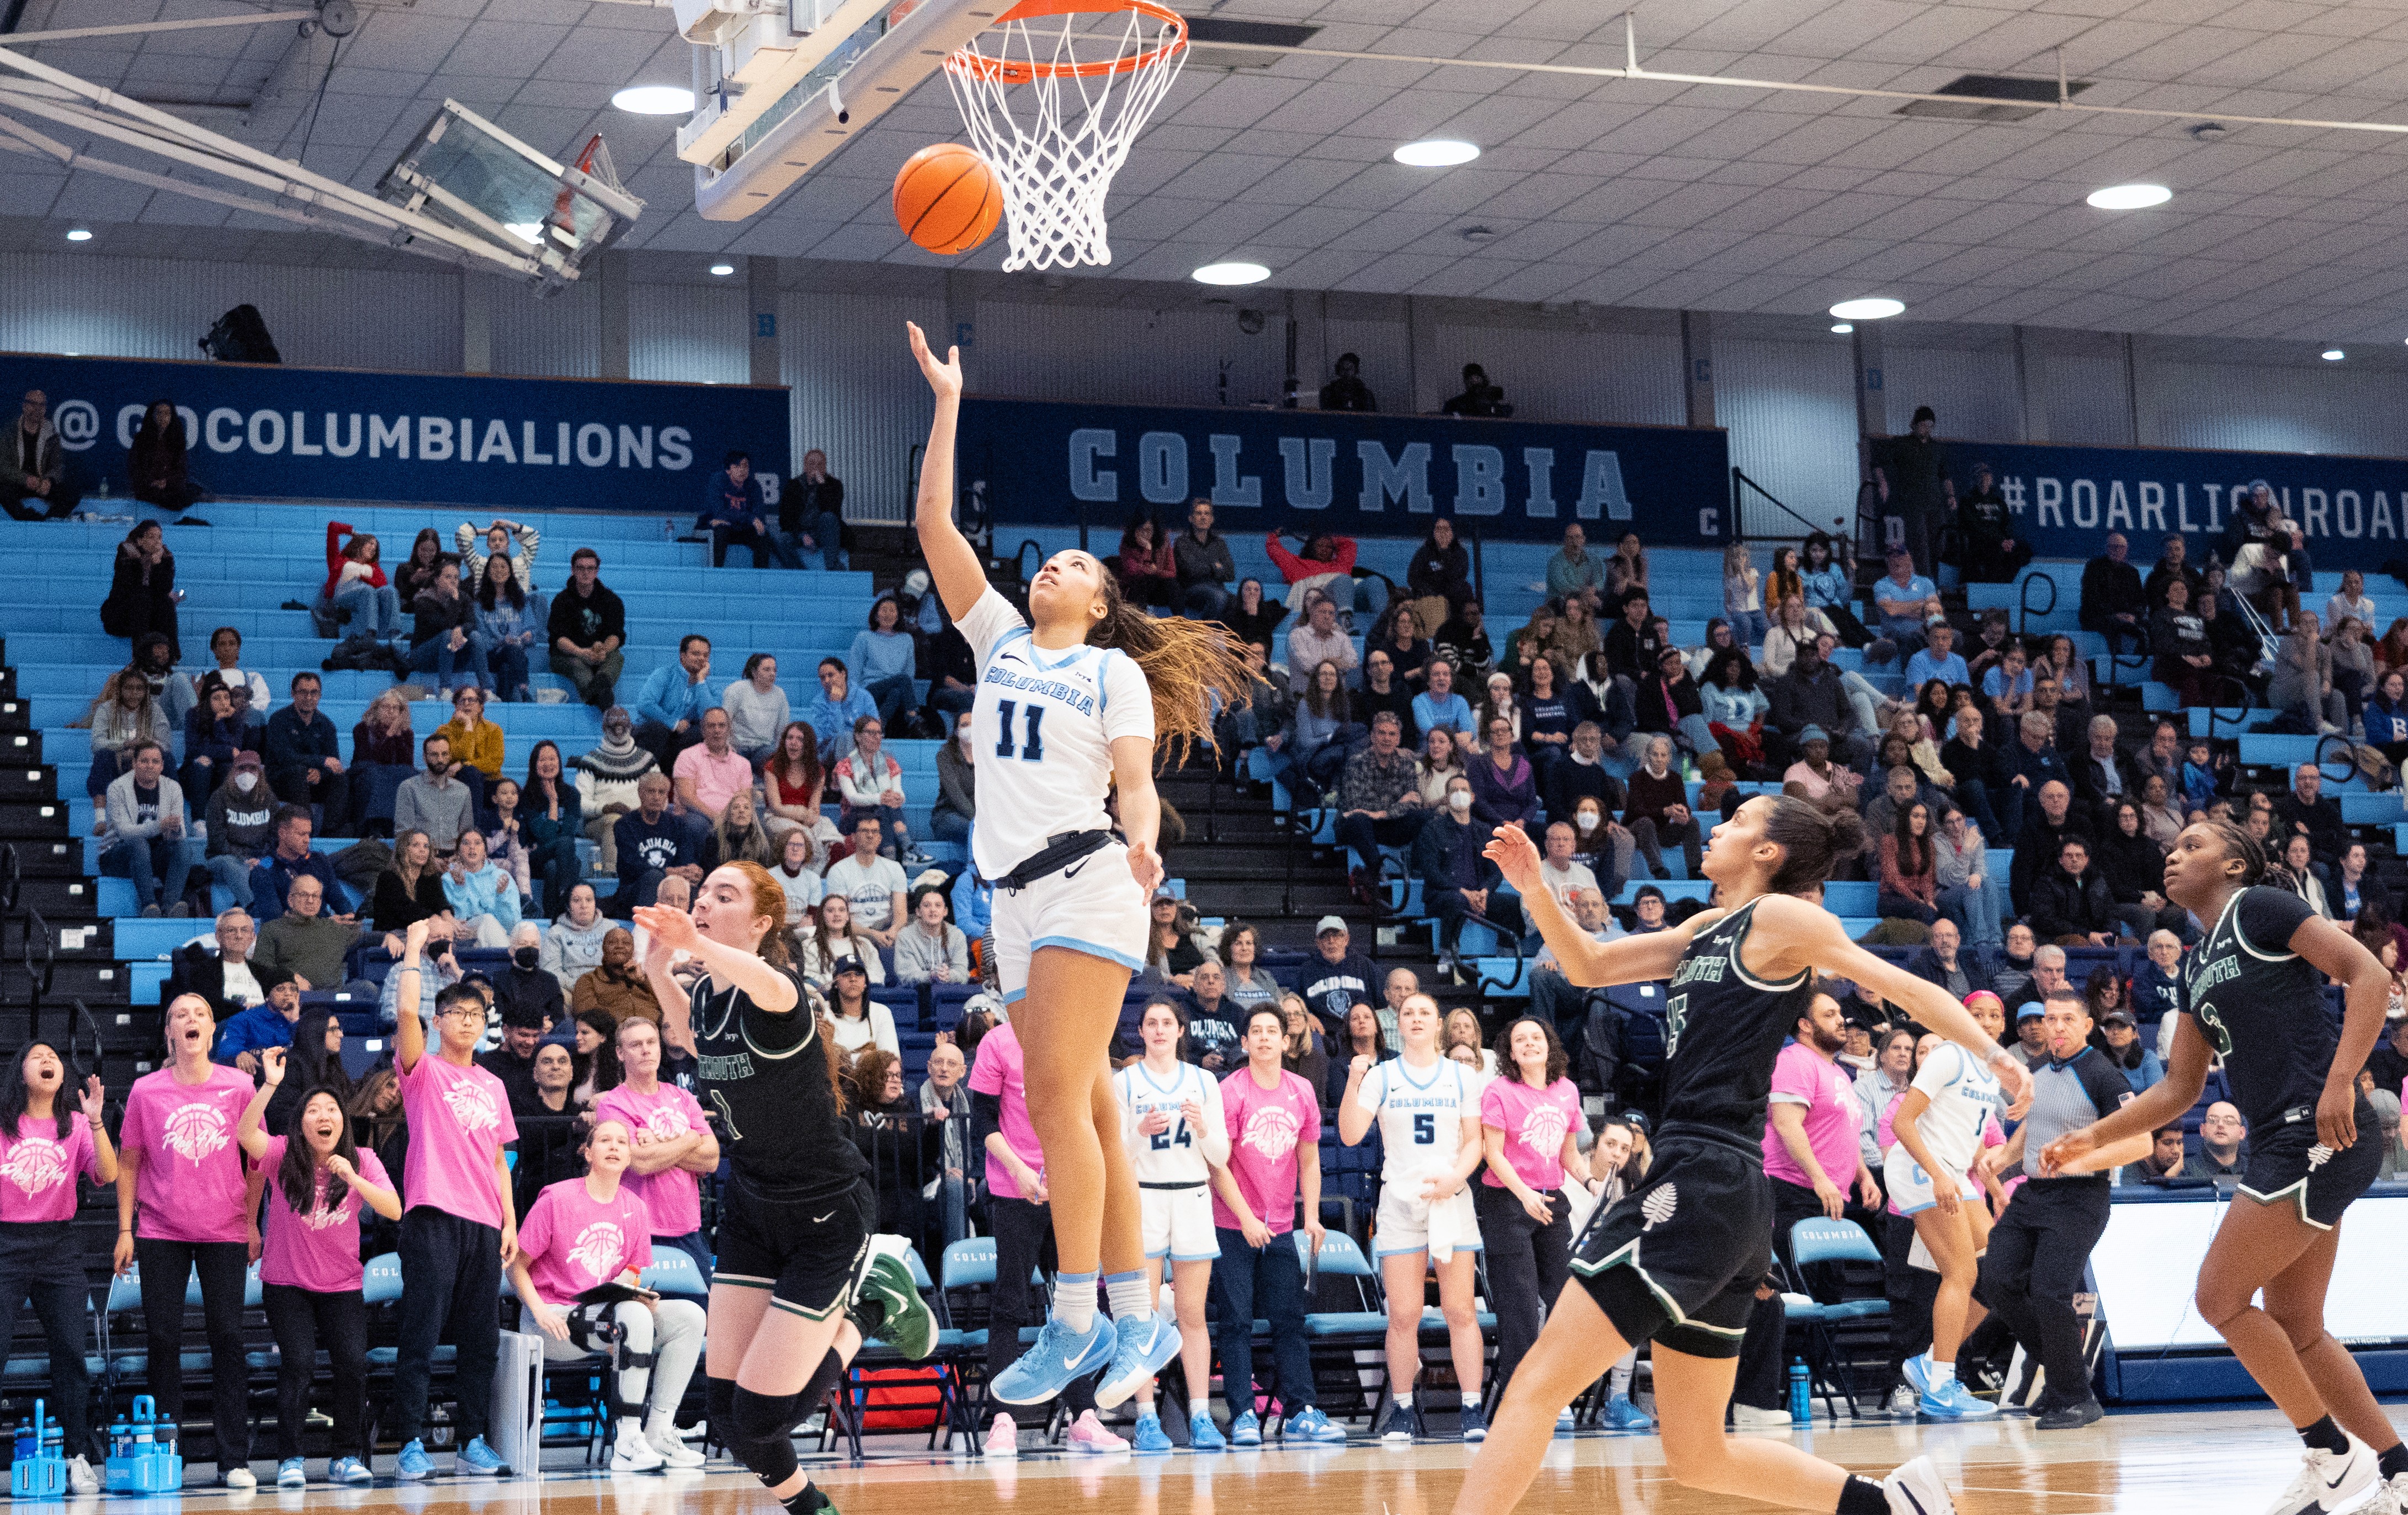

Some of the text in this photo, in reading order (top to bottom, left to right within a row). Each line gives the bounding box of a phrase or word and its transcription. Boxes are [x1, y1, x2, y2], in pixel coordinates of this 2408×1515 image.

[754, 473, 780, 504] B
[1069, 428, 1632, 521] COLUMBIA
[1699, 507, 1719, 535] C
[985, 666, 1094, 716] COLUMBIA
[996, 698, 1045, 763] 11
[2201, 1002, 2232, 1057] 3
[710, 1089, 743, 1140] 1
[1389, 1097, 1457, 1109] COLUMBIA
[1151, 1116, 1192, 1150] 24
[1413, 1114, 1435, 1145] 5
[1976, 1107, 1987, 1137] 1
[162, 1131, 194, 1153] Play
[0, 1162, 33, 1186] Play
[1801, 1230, 1863, 1240] COLUMBIA
